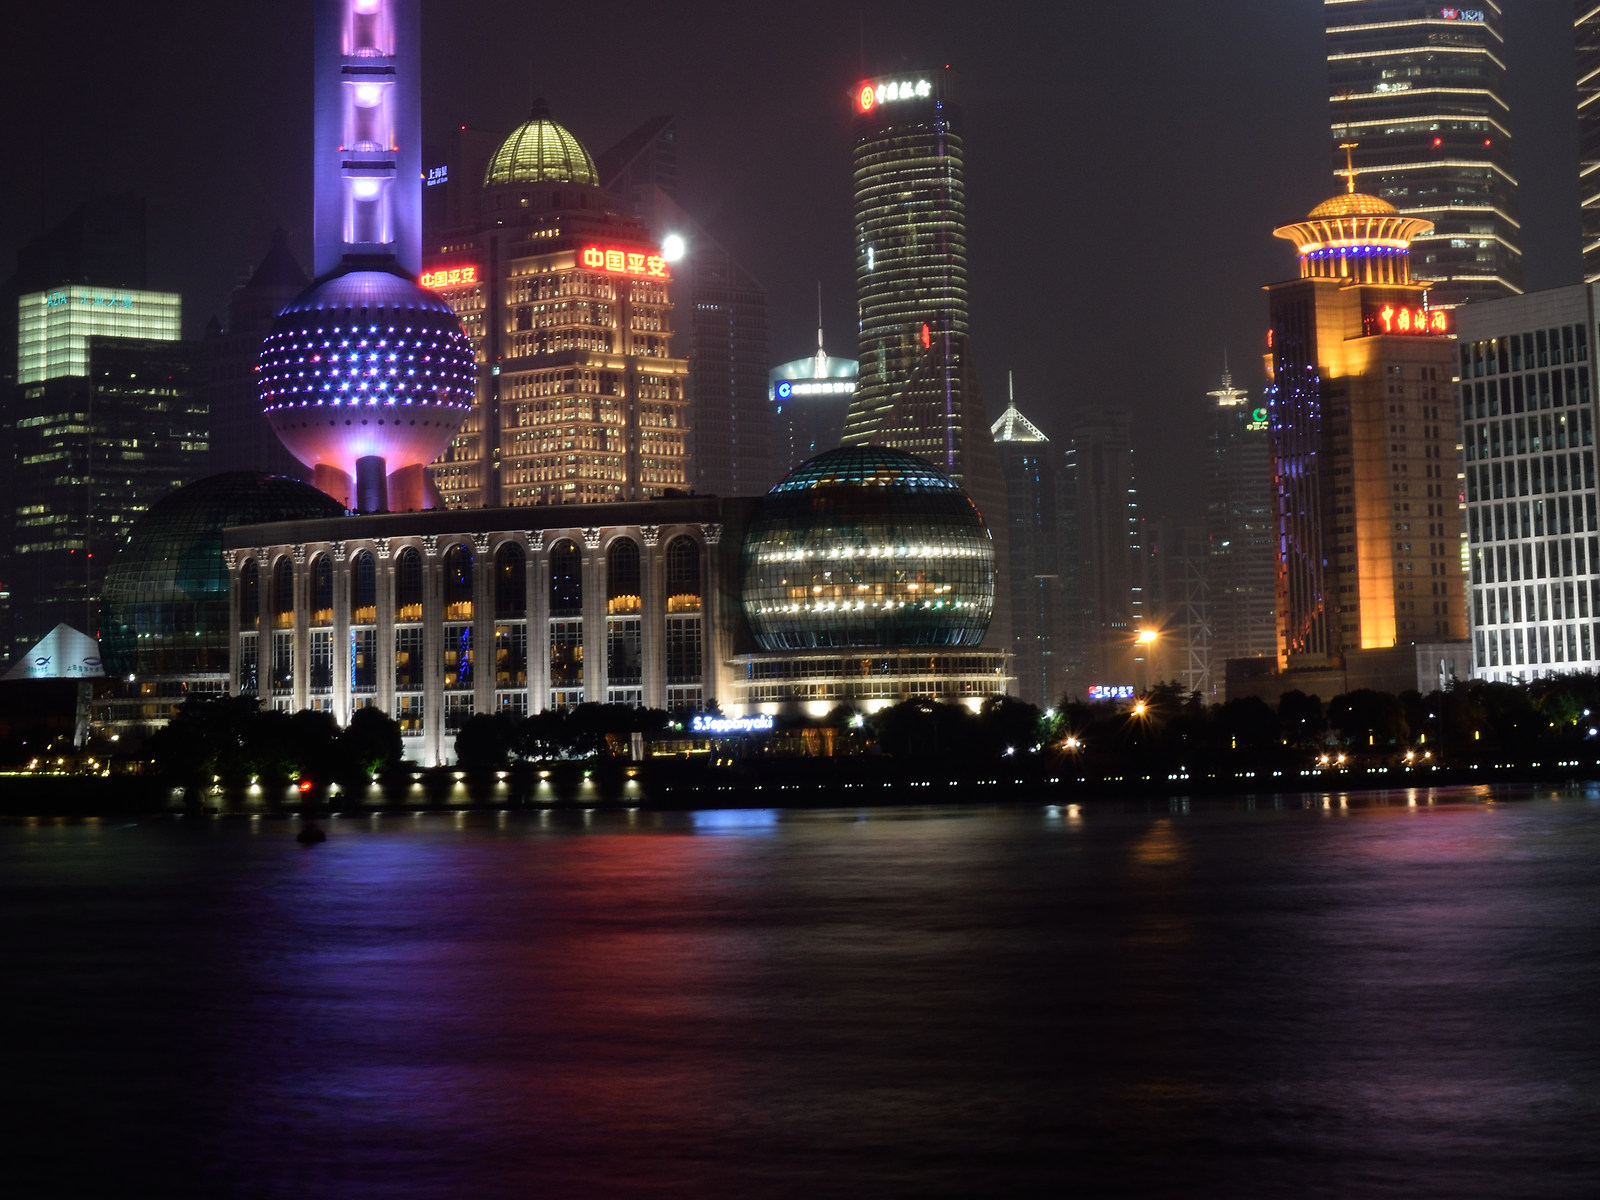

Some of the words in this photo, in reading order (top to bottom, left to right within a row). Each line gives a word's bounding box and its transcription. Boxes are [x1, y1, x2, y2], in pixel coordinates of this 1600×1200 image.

[584, 248, 665, 277] 中国平安
[421, 266, 475, 288] 中国平安
[47, 291, 67, 308] AZIA
